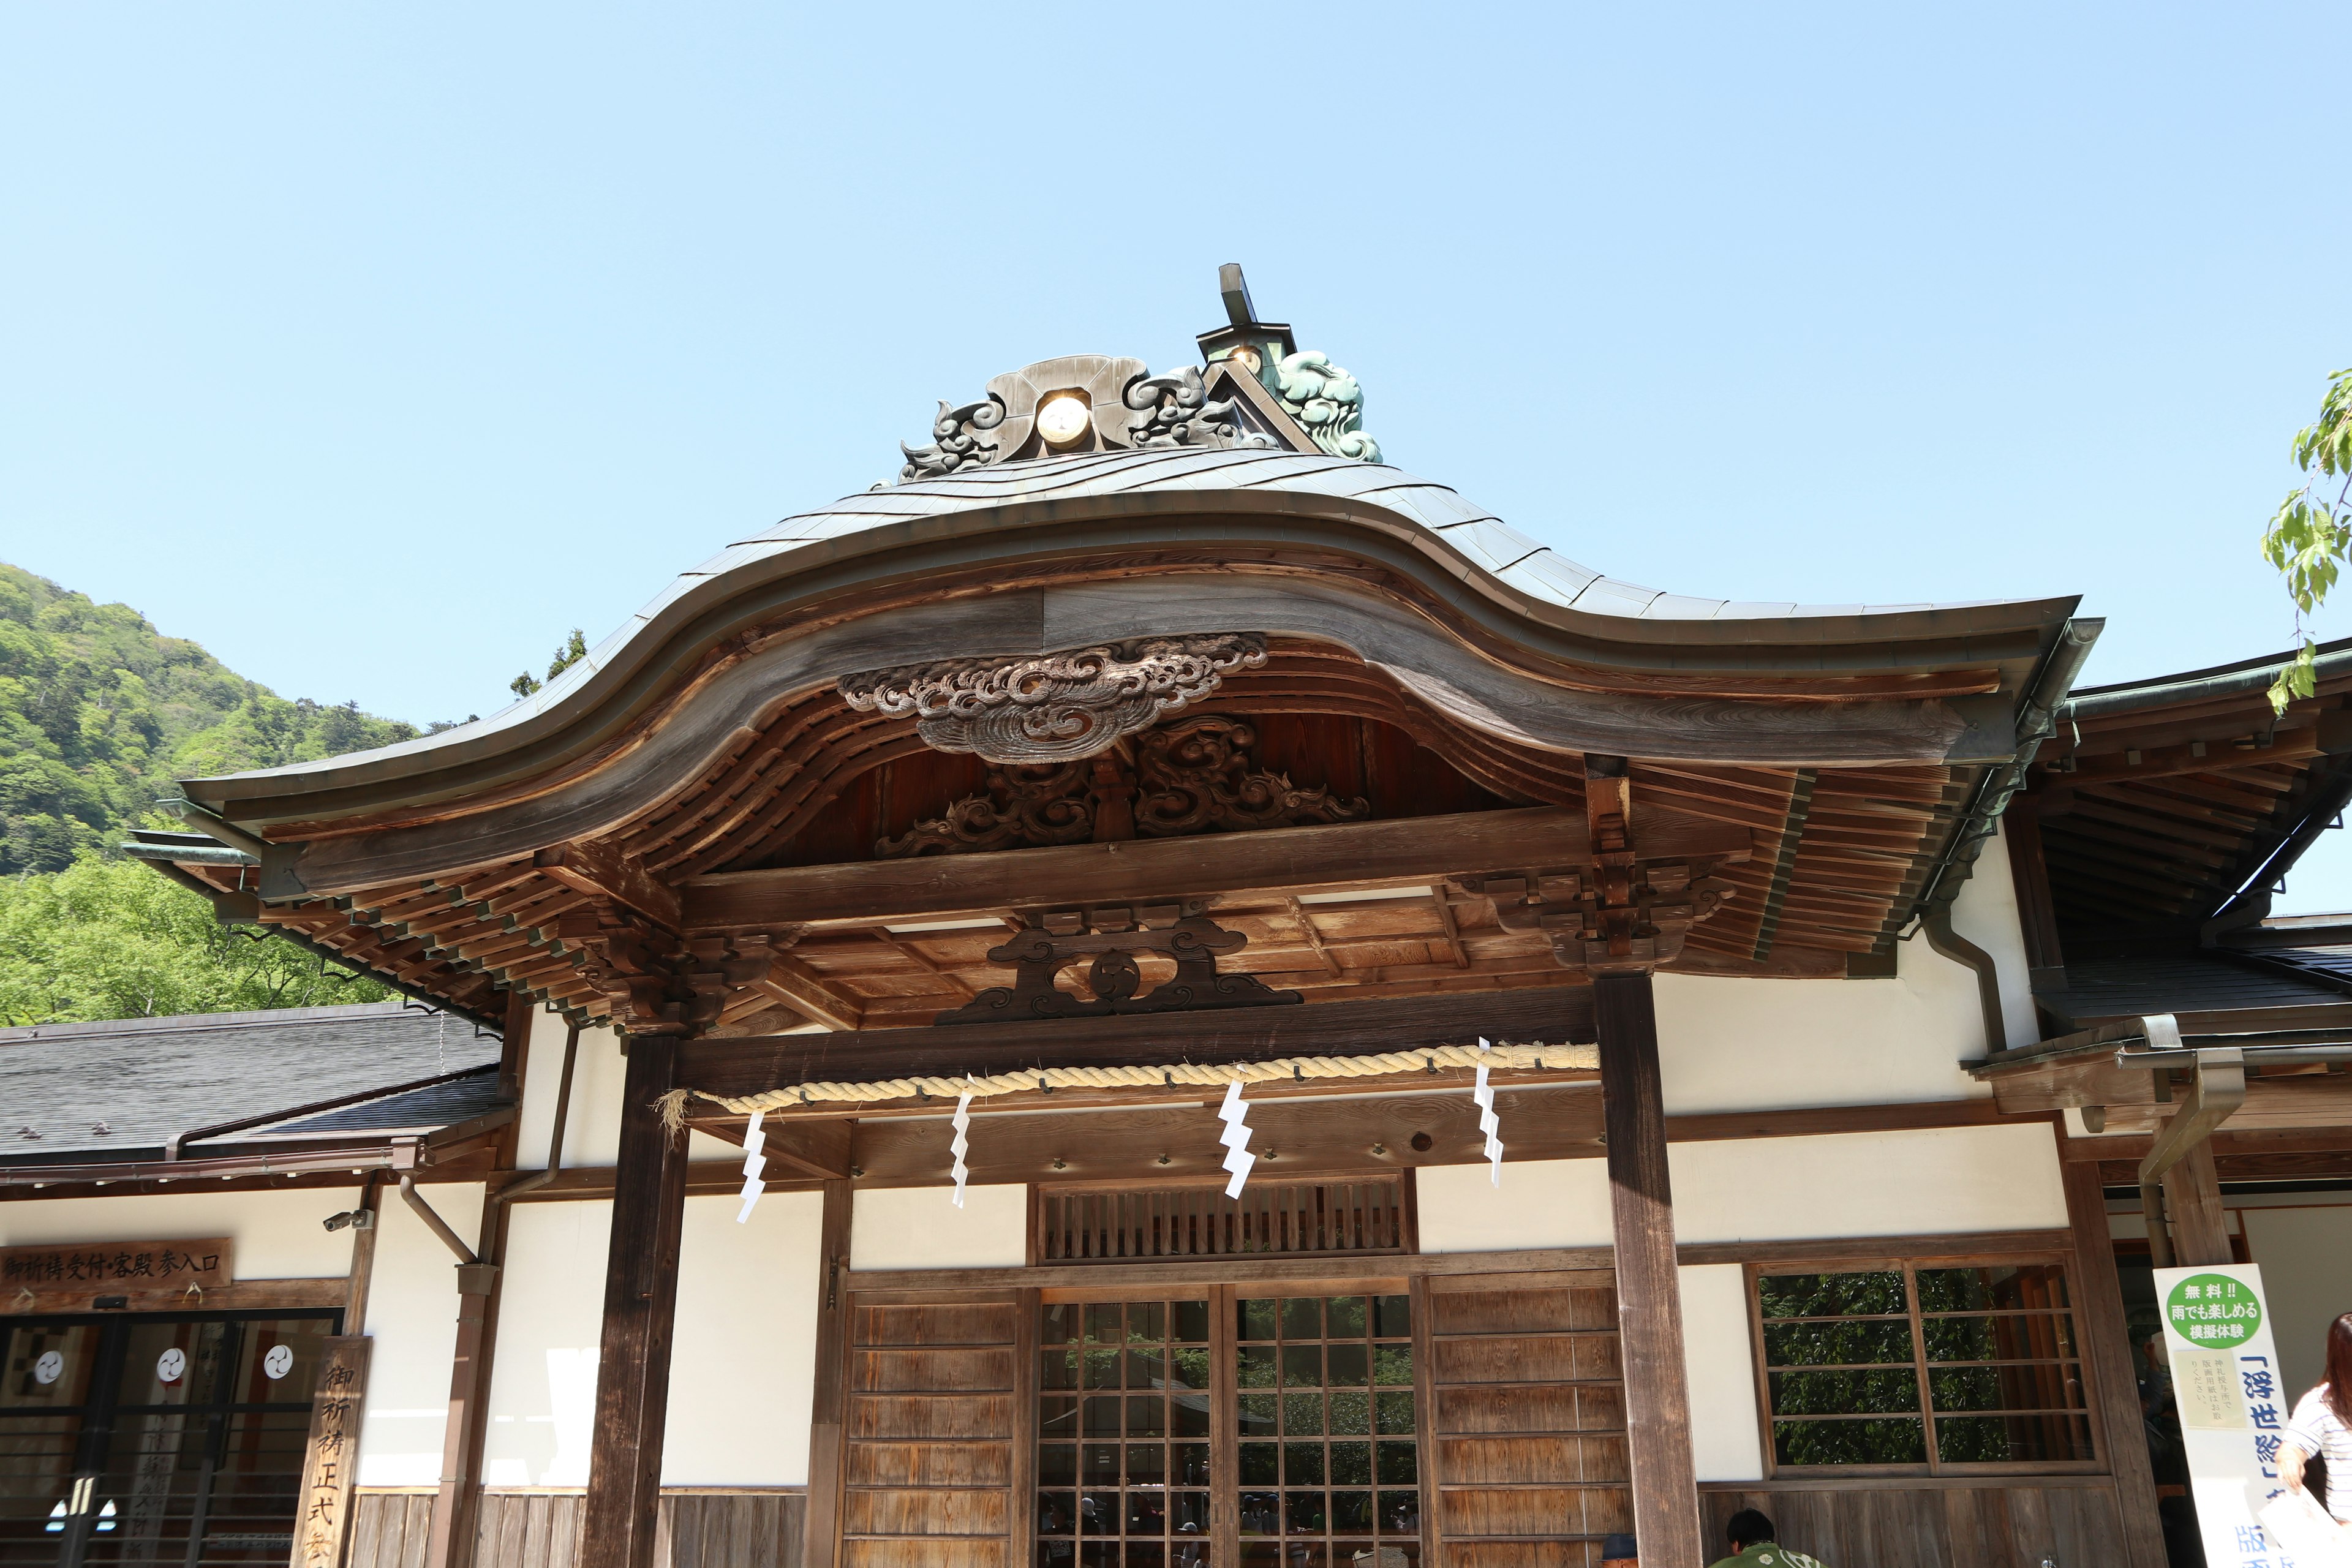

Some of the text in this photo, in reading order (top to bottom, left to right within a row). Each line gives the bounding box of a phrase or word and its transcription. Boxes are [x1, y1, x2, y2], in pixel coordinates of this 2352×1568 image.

[2171, 1302, 2258, 1321] 雨でも楽しめる
[2189, 1324, 2245, 1340] 模擬体験
[2191, 1360, 2207, 1404] りください。
[2202, 1359, 2222, 1420] 版画用紙はお取
[2215, 1359, 2232, 1409] 神札授与所で
[303, 1365, 354, 1568] 御祈祷正式参
